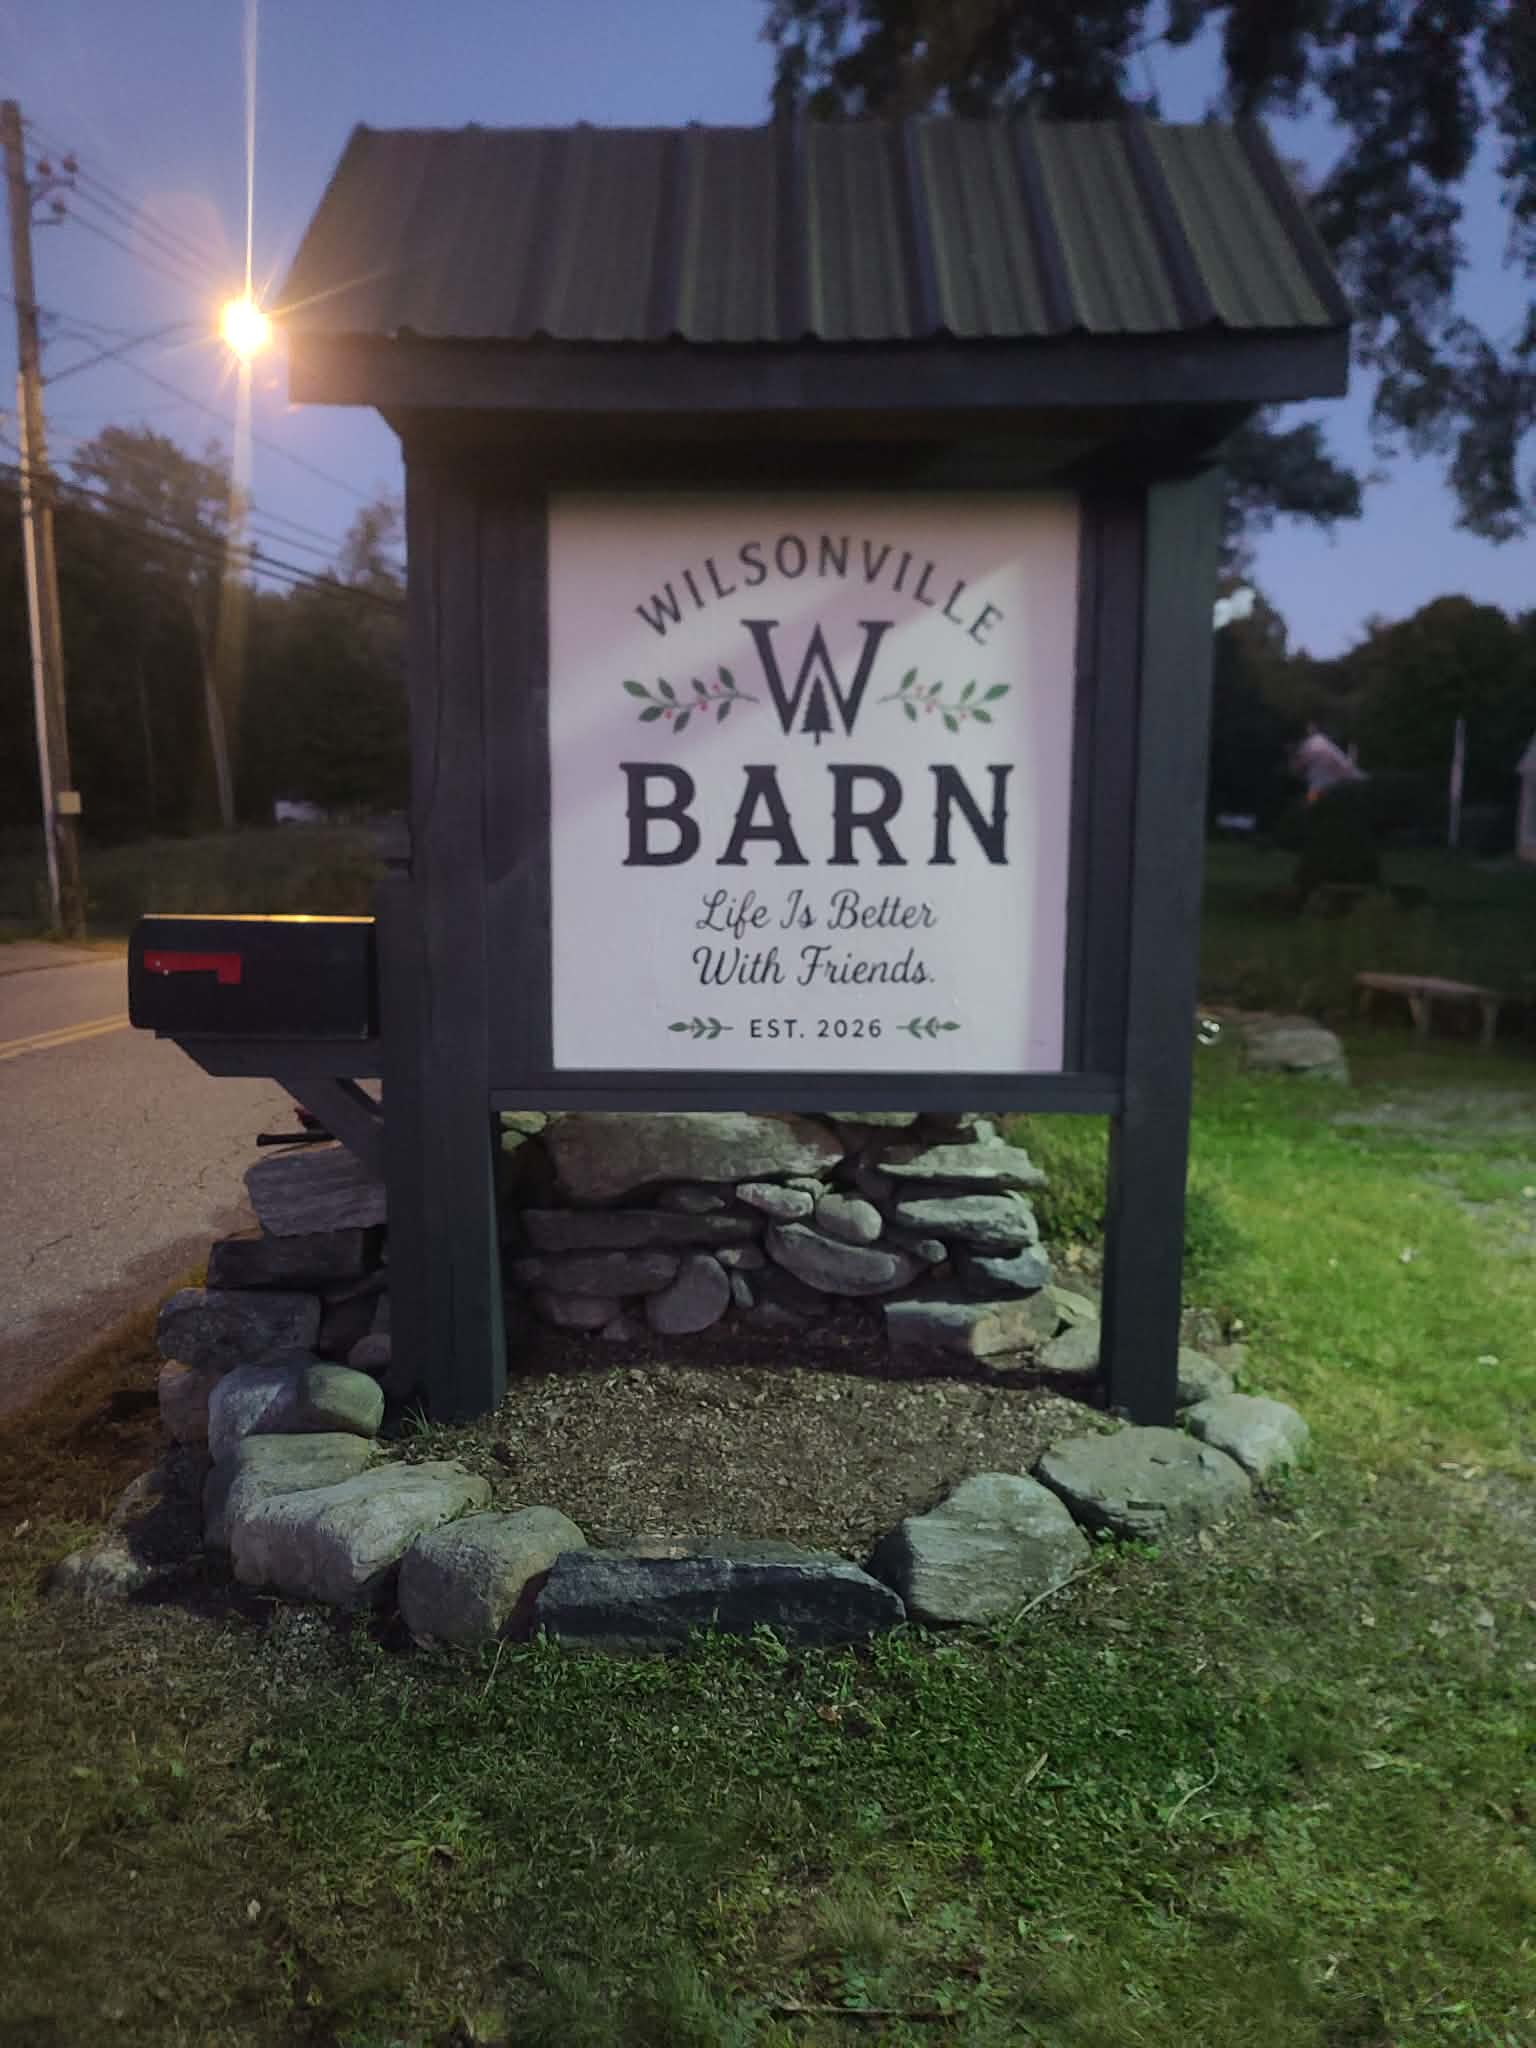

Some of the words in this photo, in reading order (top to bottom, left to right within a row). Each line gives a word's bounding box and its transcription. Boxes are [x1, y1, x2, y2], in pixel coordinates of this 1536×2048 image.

[635, 534, 1003, 645] WILSONVILLE
[619, 762, 1014, 866] BARN
[695, 889, 770, 940] Life
[780, 889, 816, 929] Is
[827, 888, 938, 929] Better
[692, 946, 785, 985] With
[796, 944, 936, 985] Friends.
[749, 1018, 805, 1039] EST.
[816, 1018, 883, 1039] 2026
